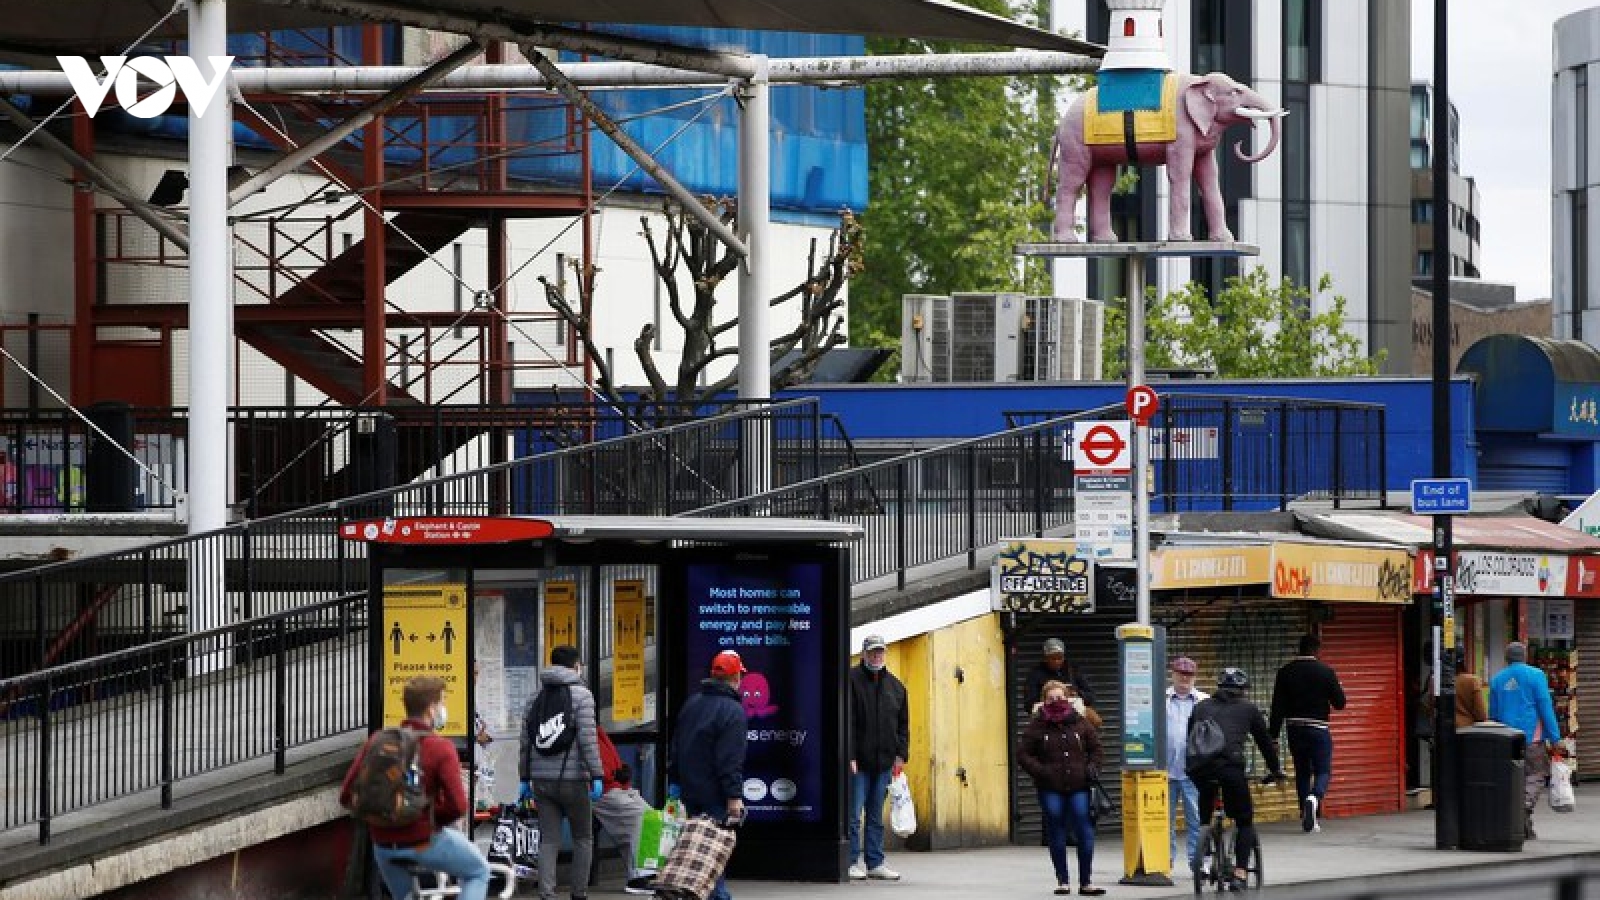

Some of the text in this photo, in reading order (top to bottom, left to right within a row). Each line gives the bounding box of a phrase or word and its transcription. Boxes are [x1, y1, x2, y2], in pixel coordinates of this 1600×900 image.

[1134, 392, 1150, 414] P
[1421, 485, 1461, 495] End of
[1417, 498, 1465, 508] bus lane
[414, 522, 447, 532] Elephant
[456, 522, 481, 530] Castle
[1003, 577, 1086, 590] OFF-LICENCE
[709, 587, 801, 599] Most homes can
[699, 602, 811, 614] switch to renewable
[699, 621, 738, 632] energy
[741, 618, 763, 630] and
[765, 621, 787, 632] pay
[718, 637, 735, 646] on
[735, 634, 763, 646] their
[393, 661, 453, 673] Please keep
